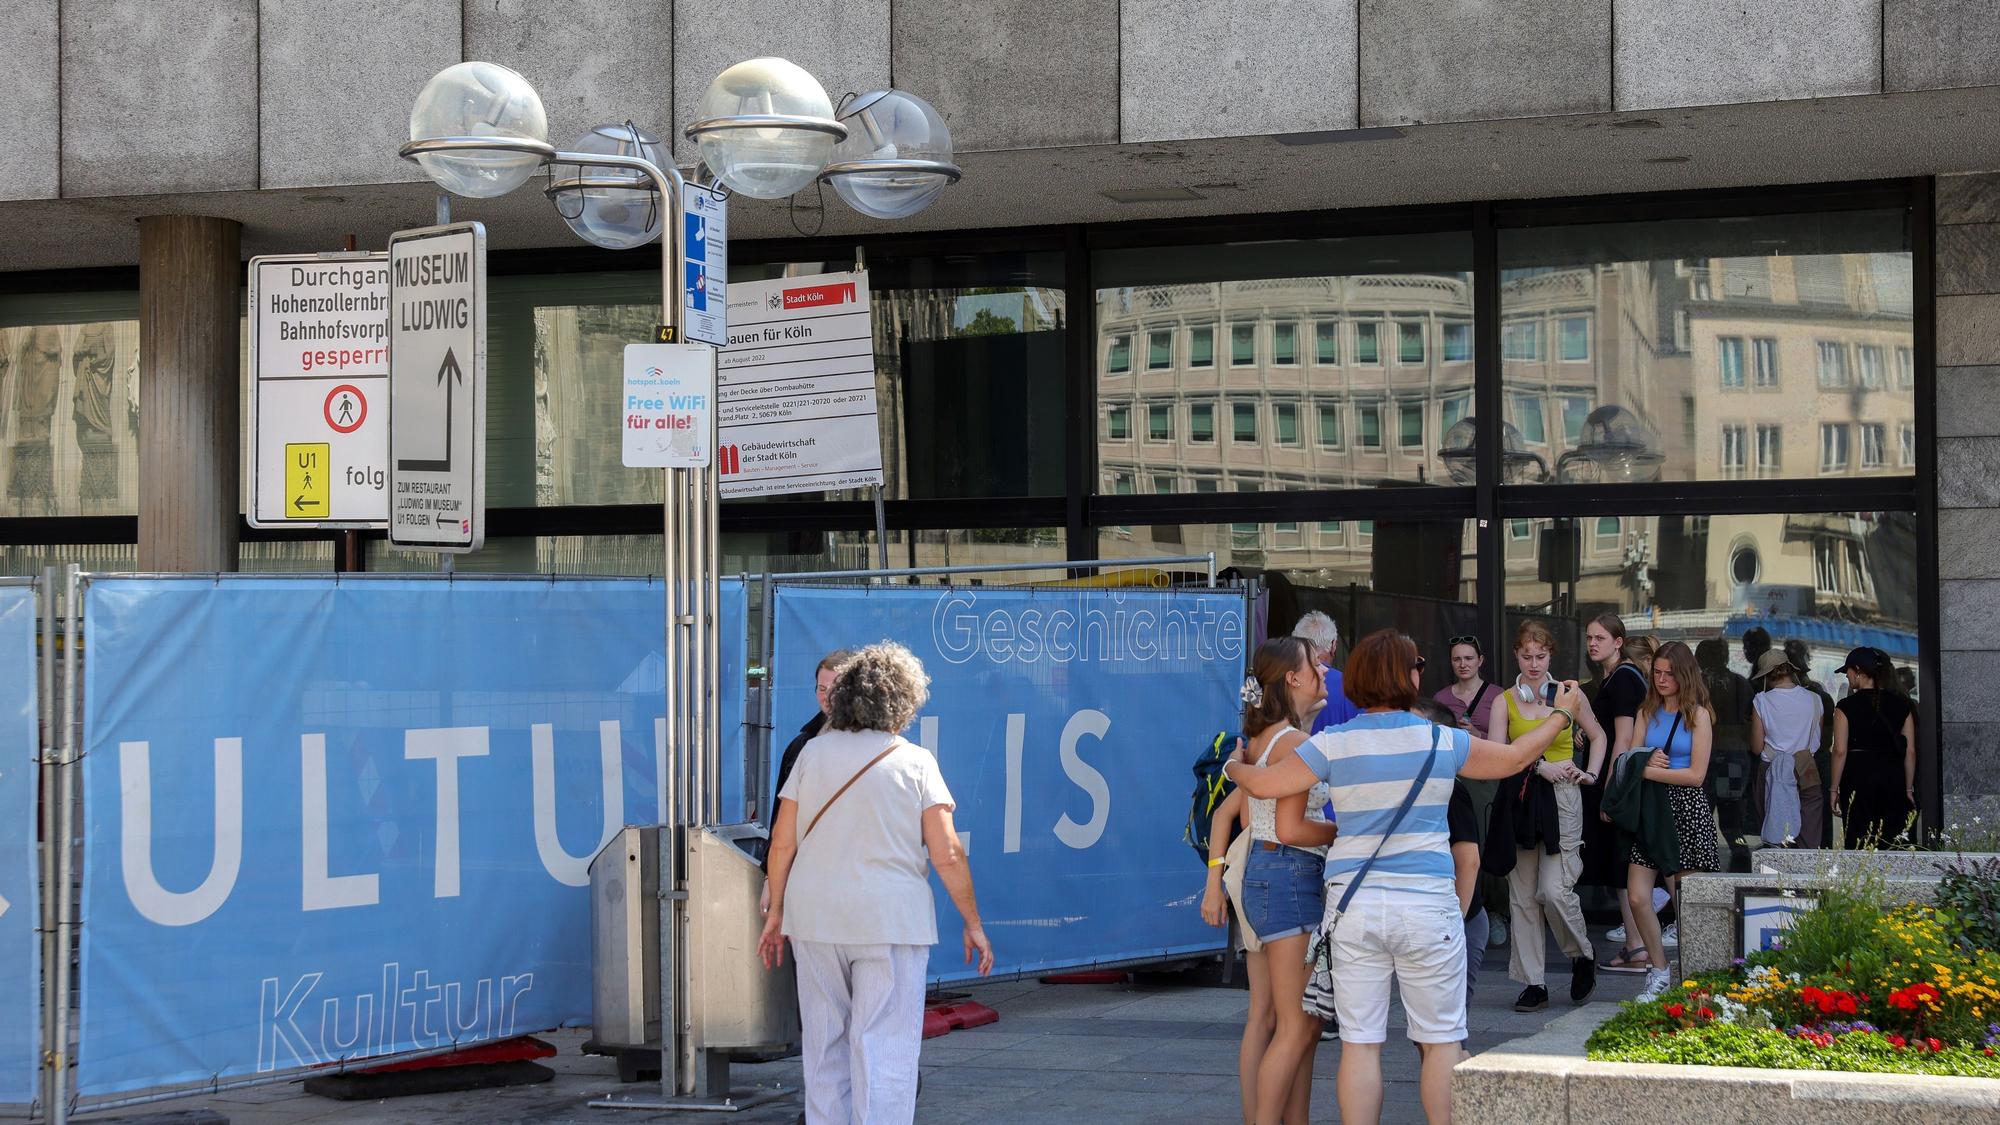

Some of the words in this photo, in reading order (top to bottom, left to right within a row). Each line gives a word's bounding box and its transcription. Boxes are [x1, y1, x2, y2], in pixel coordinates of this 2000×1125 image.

[396, 252, 468, 287] MUSEUM
[292, 266, 388, 290] Durchgan
[786, 294, 805, 304] Stadt
[807, 291, 824, 301] Köln
[402, 298, 468, 331] LUDWIG
[661, 329, 673, 340] 47
[763, 328, 782, 341] für
[785, 325, 812, 338] Köln
[732, 356, 751, 365] August
[627, 378, 680, 387] hotspot.koeln
[741, 387, 758, 395] Decke
[760, 384, 773, 393] über
[774, 382, 815, 392] Dombauhütte
[628, 396, 664, 410] Free
[669, 396, 705, 410] WiFi
[735, 403, 780, 413] Serviceleitstelle
[833, 396, 847, 404] oder
[848, 394, 867, 403] 20721
[759, 411, 777, 419] 50679
[778, 409, 792, 417] Köln
[627, 415, 650, 429] für
[655, 415, 691, 429] alle!
[741, 437, 816, 452] Gebäudewirtschaft
[299, 453, 316, 468] U1
[742, 454, 755, 463] der
[757, 452, 778, 462] Stadt
[779, 450, 797, 460] Köln
[765, 463, 796, 473] Management
[346, 466, 388, 491] folg
[849, 476, 863, 484] Stadt
[397, 482, 410, 493] ZUM
[411, 482, 451, 494] RESTAURANT
[425, 499, 432, 509] IM
[397, 513, 404, 524] U1
[406, 514, 430, 525] FOLGEN
[933, 589, 1243, 663] Geschichte
[119, 716, 680, 926] ULTU
[258, 963, 533, 1072] Kultur
